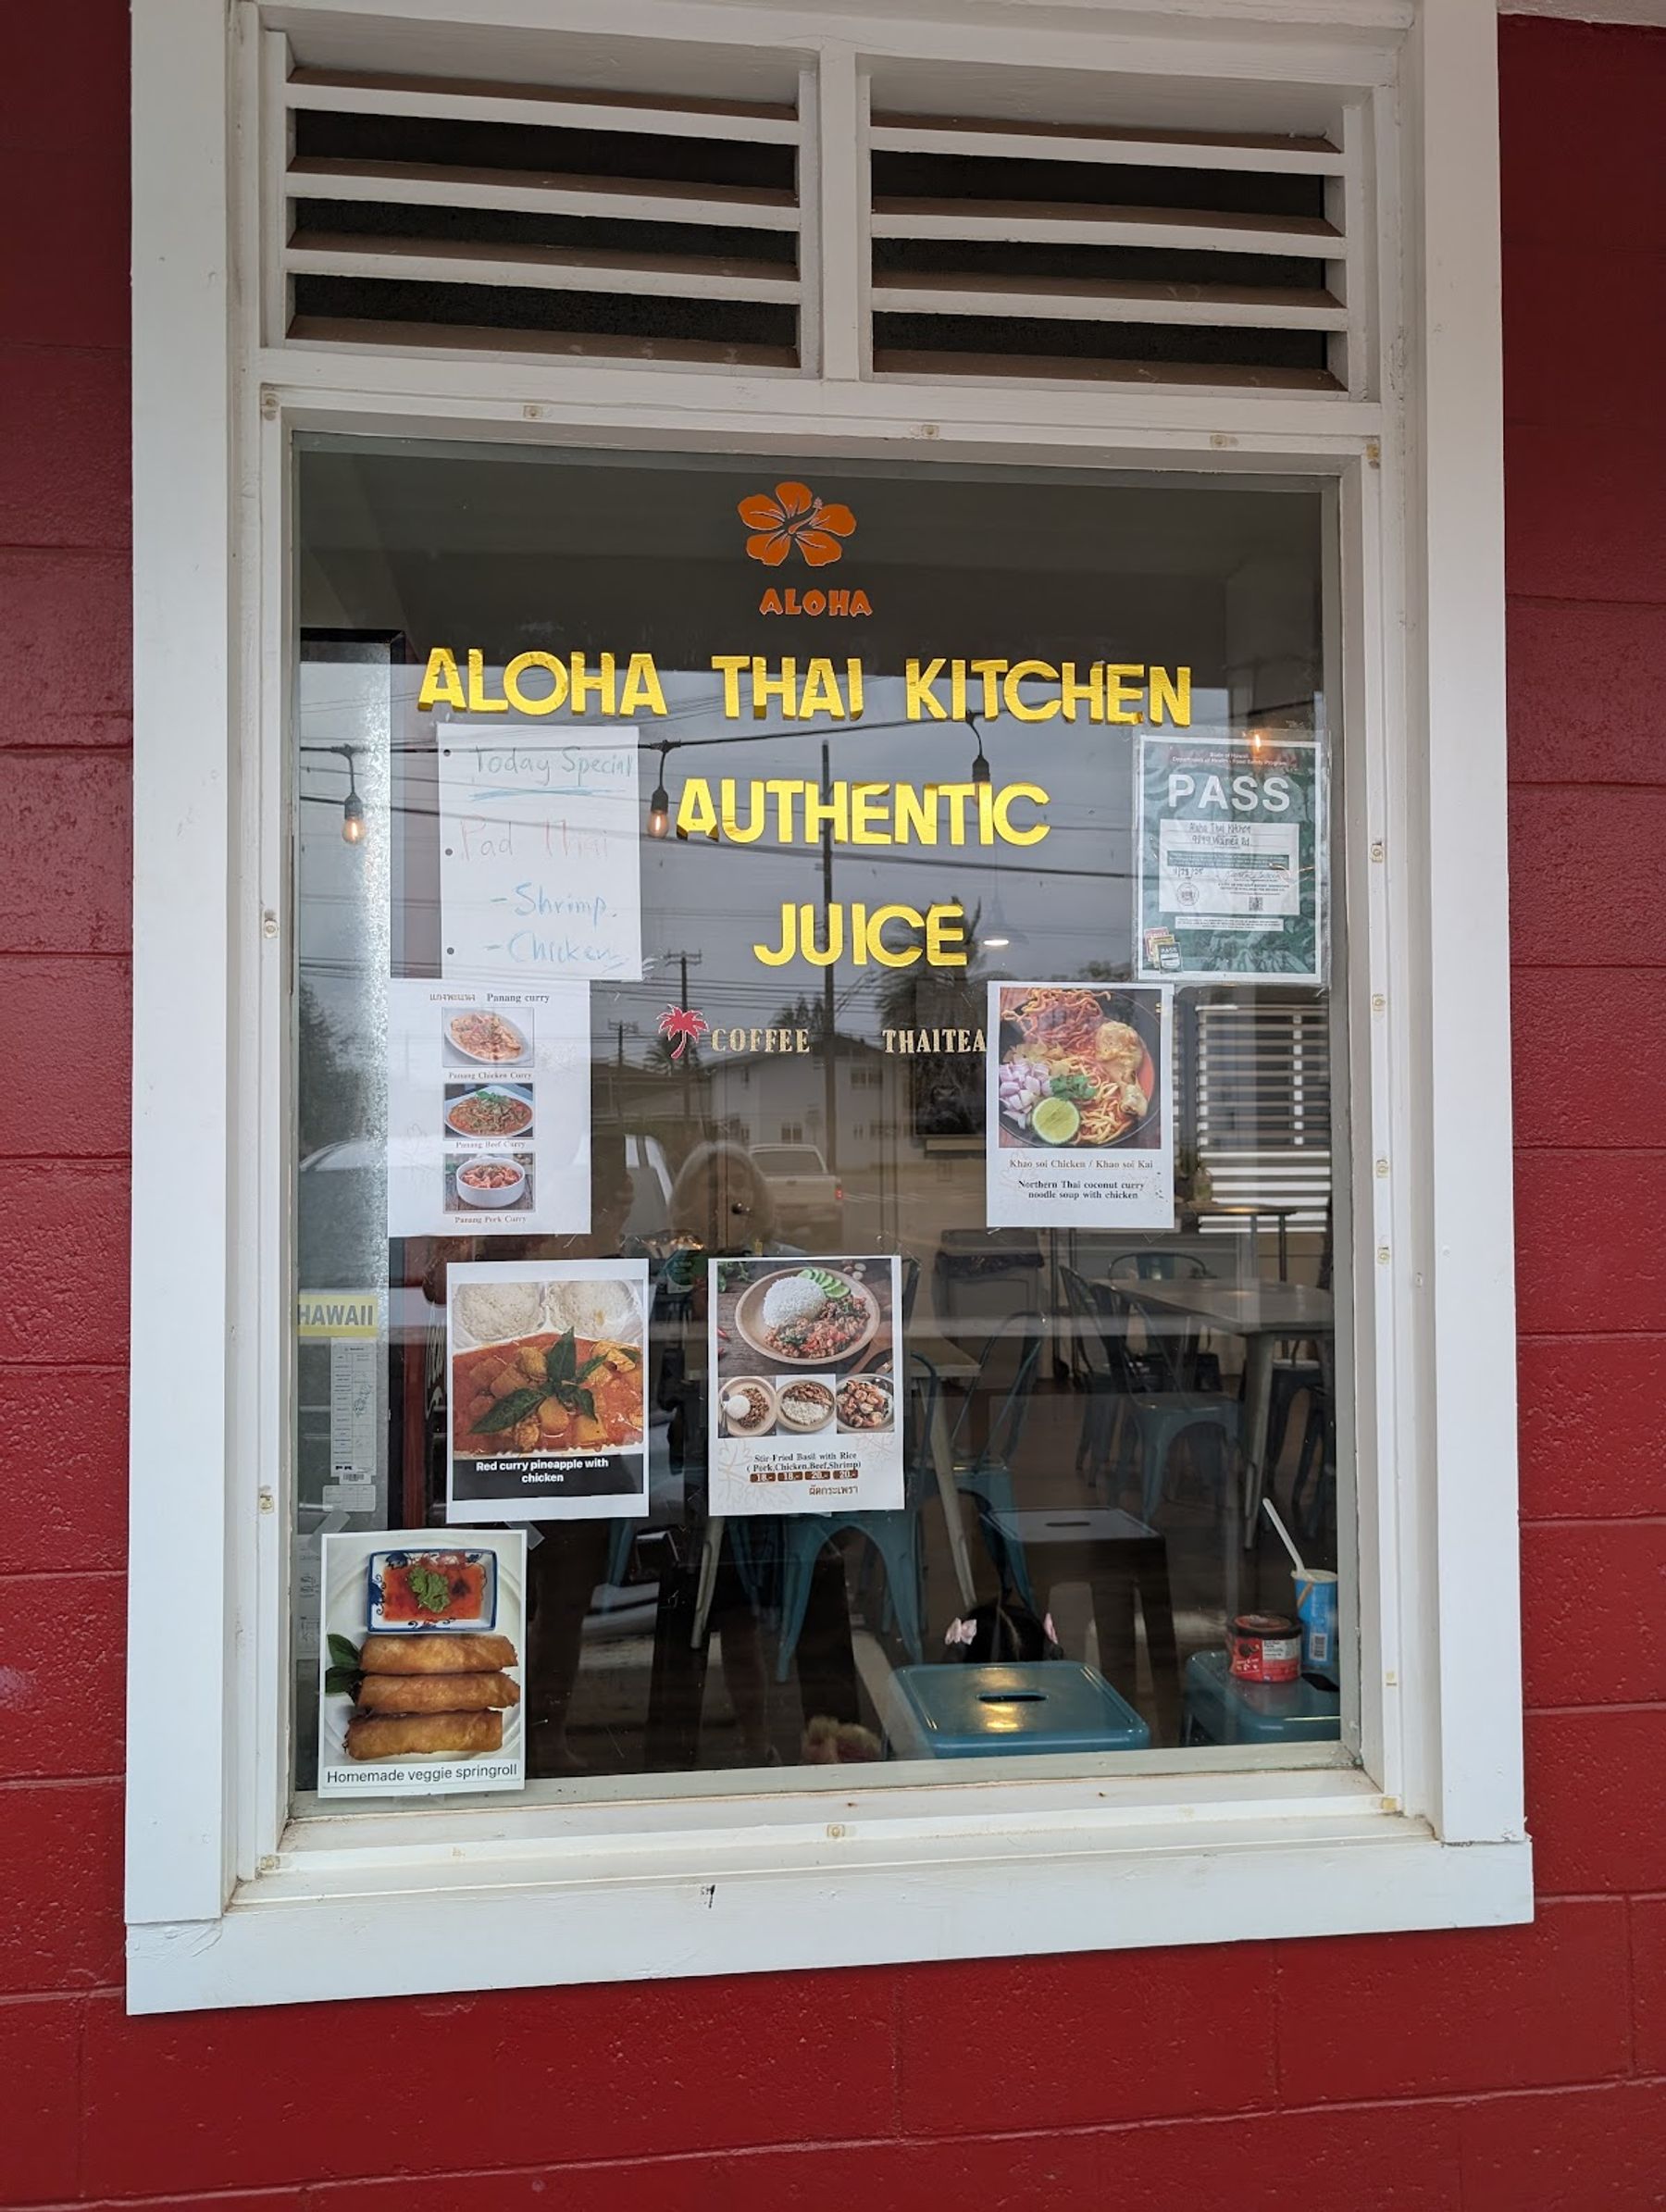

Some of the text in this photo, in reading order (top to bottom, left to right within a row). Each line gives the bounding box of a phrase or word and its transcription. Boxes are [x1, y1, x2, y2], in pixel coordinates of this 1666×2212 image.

[759, 588, 874, 616] ALOHA
[417, 647, 1191, 727] ALOHA THAI KITCHEN
[470, 745, 633, 787] Today Special
[1167, 774, 1291, 812] PASS
[677, 778, 1051, 847] AUTHENTIC
[753, 901, 968, 968] JUICE
[487, 993, 550, 1004] Panang curry
[710, 1028, 811, 1053] COFFEE
[1009, 1160, 1033, 1168] Khao
[1036, 1160, 1048, 1168] soi
[1051, 1160, 1086, 1168] Chicken
[1096, 1160, 1120, 1168] Khao
[1123, 1160, 1135, 1169] soi
[1138, 1160, 1153, 1169] Kai
[1018, 1180, 1144, 1191] Northern Thai coconut curry
[1028, 1190, 1138, 1200] noodle soup with chicken
[298, 1304, 374, 1327] HAWAII
[476, 1457, 609, 1473] Red curry pineapple with
[796, 1452, 816, 1461] Basil
[819, 1452, 837, 1460] with
[839, 1451, 857, 1460] Rice
[521, 1473, 565, 1484] chicken
[327, 1763, 517, 1783] Homemade veggie springroll
